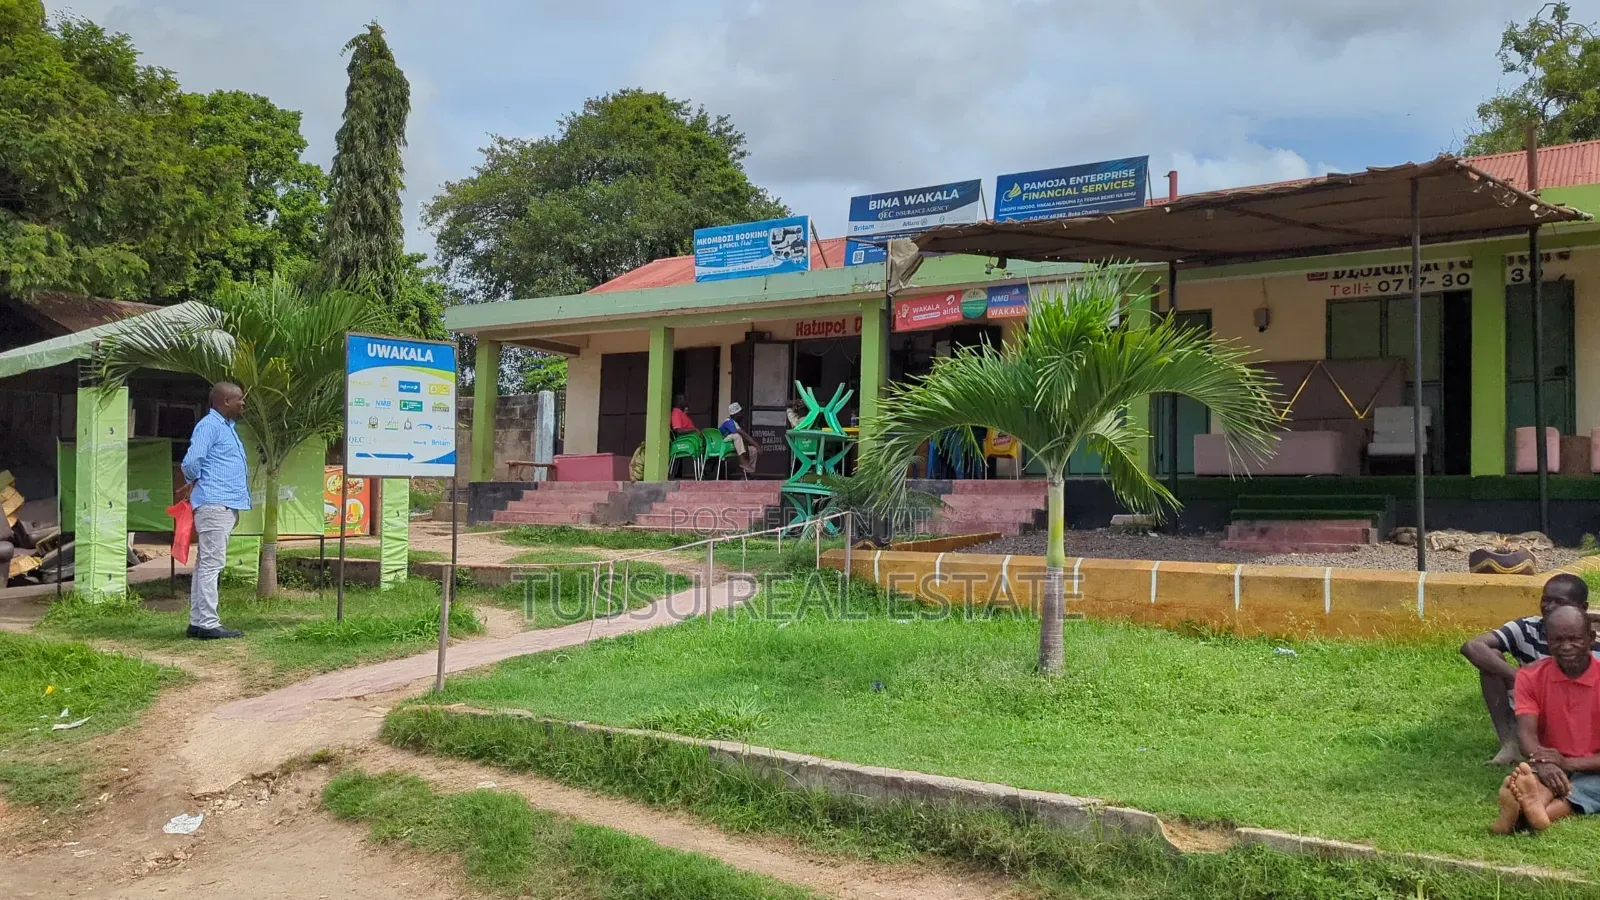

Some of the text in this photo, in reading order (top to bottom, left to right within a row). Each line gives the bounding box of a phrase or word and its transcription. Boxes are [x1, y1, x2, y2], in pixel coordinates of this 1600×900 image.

[1023, 168, 1136, 191] PAMOJA ENTERPRISE
[1022, 179, 1136, 200] FINANCIAL SERVICES
[868, 188, 959, 210] BIMA WAKALA
[895, 208, 925, 217] INSURANCE
[925, 205, 949, 213] AGENCY
[696, 234, 734, 246] MKOMBOZI
[736, 230, 768, 241] BOOKING
[991, 294, 1009, 303] NMB
[912, 304, 940, 314] WAKALA
[942, 306, 960, 316] airtel
[991, 306, 1027, 316] WAKALA
[367, 343, 434, 362] UWAKALA
[349, 436, 364, 444] QEC
